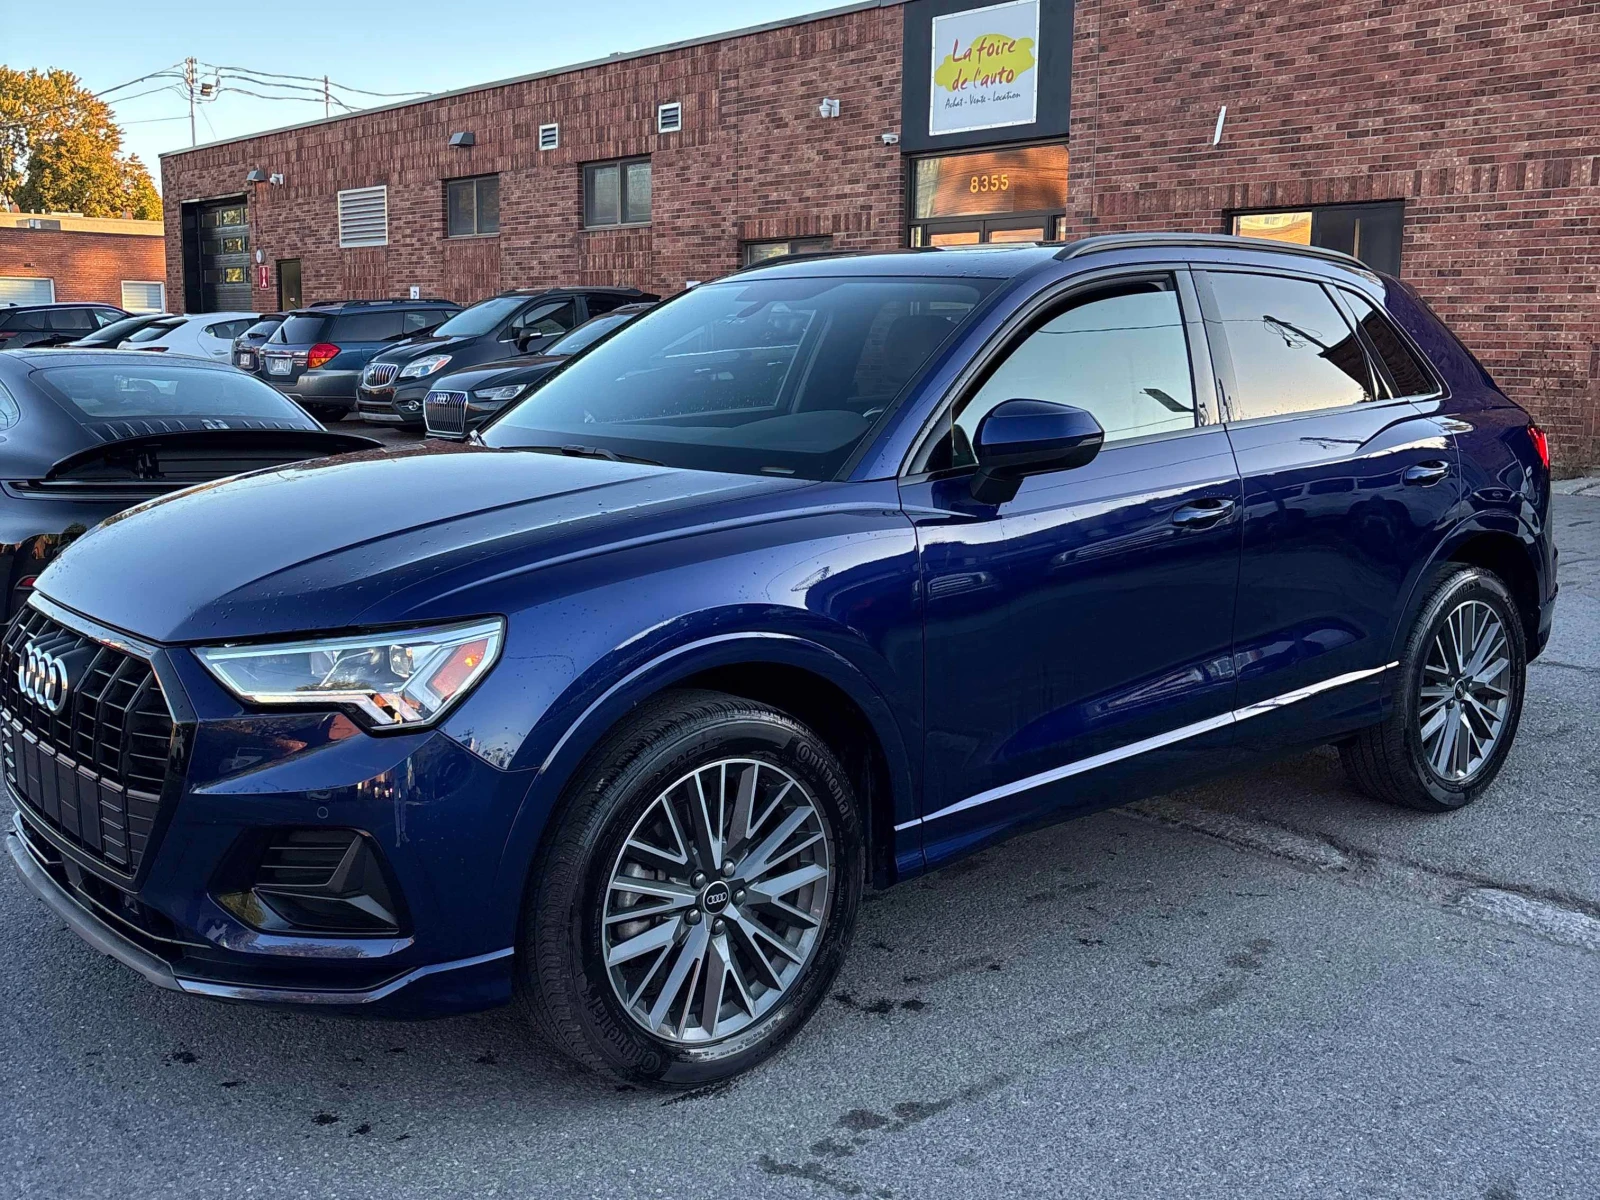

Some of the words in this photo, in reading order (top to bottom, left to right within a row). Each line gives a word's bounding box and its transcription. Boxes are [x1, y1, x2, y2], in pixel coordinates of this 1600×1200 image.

[952, 38, 972, 62] La
[976, 37, 1016, 64] foire
[952, 68, 968, 92] de
[973, 66, 1015, 88] l'auto
[945, 97, 963, 109] Achat
[969, 94, 986, 105] Vente
[992, 91, 1021, 102] Location
[970, 174, 1009, 193] 8355
[795, 741, 854, 822] Continental
